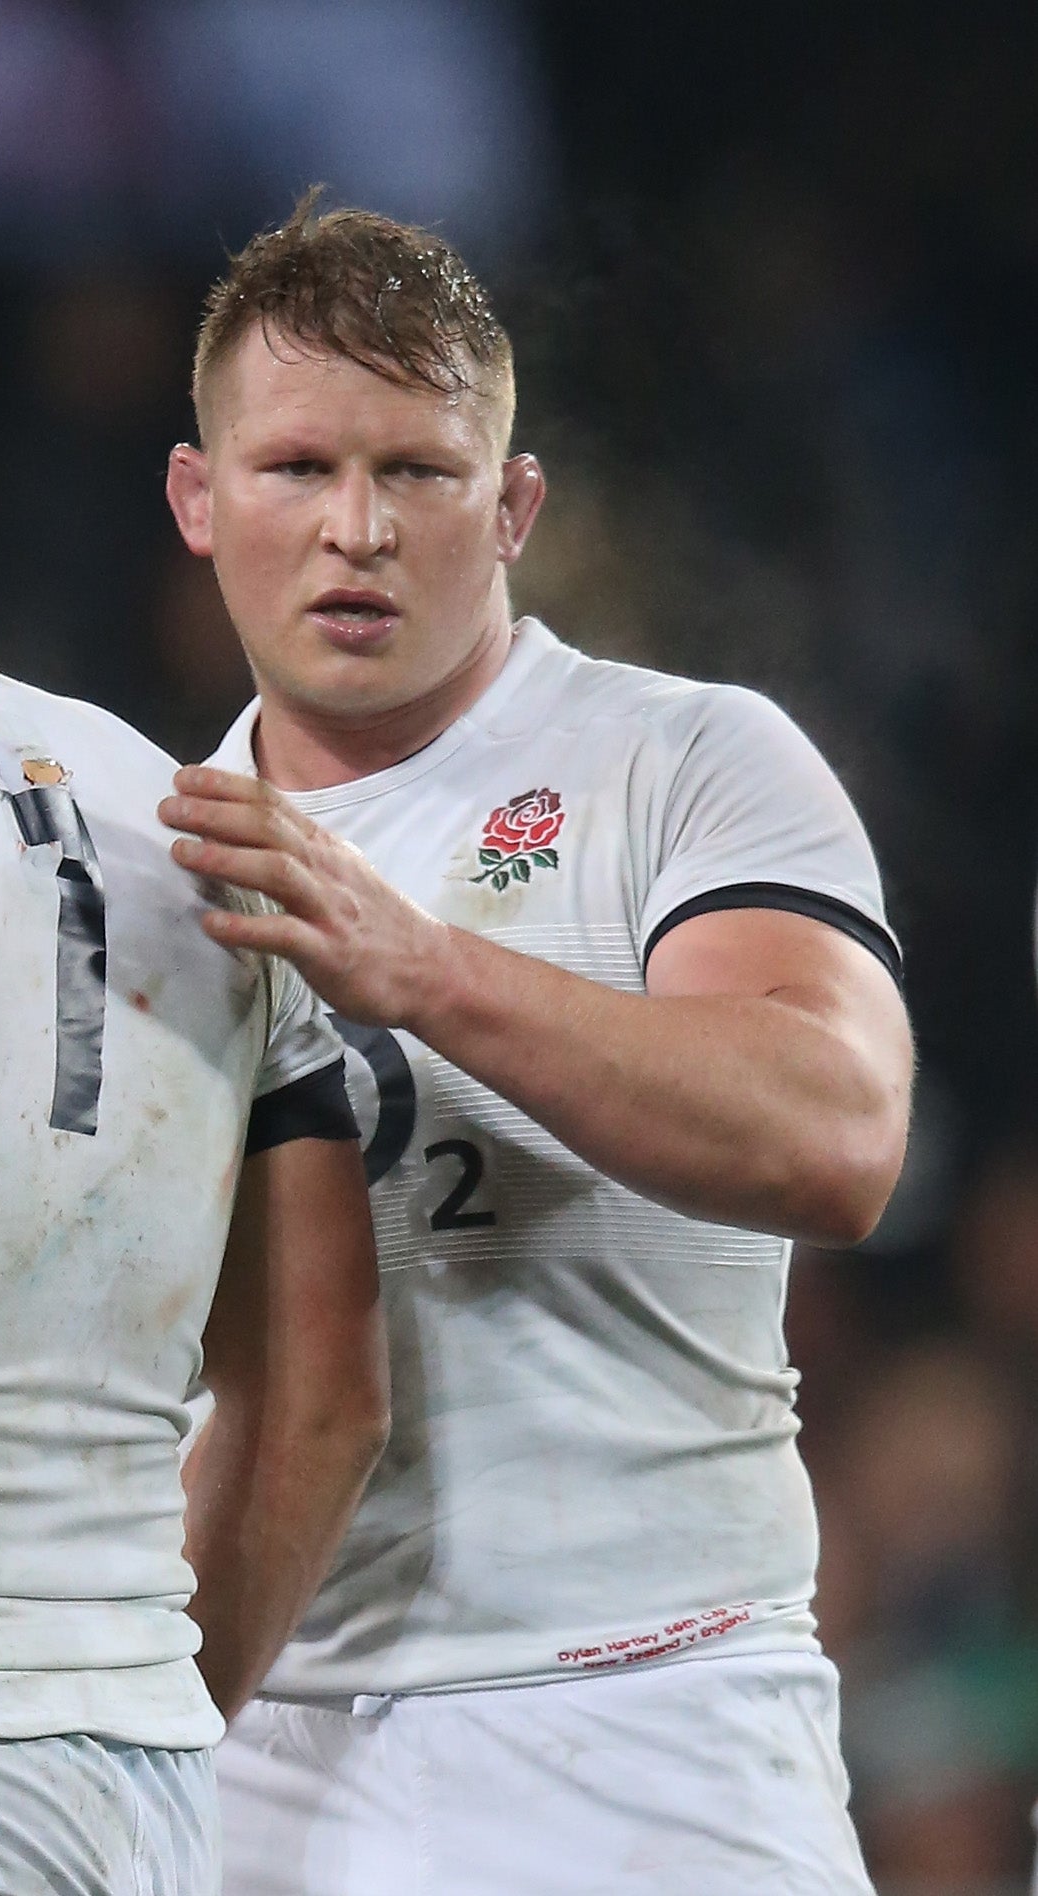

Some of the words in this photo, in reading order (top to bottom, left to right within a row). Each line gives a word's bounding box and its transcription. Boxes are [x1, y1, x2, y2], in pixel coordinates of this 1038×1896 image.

[557, 1646, 602, 1662] Dylan
[605, 1633, 659, 1652] Hartley
[623, 1638, 681, 1662] Zealand
[686, 1634, 697, 1642] v
[700, 1610, 750, 1638] England
